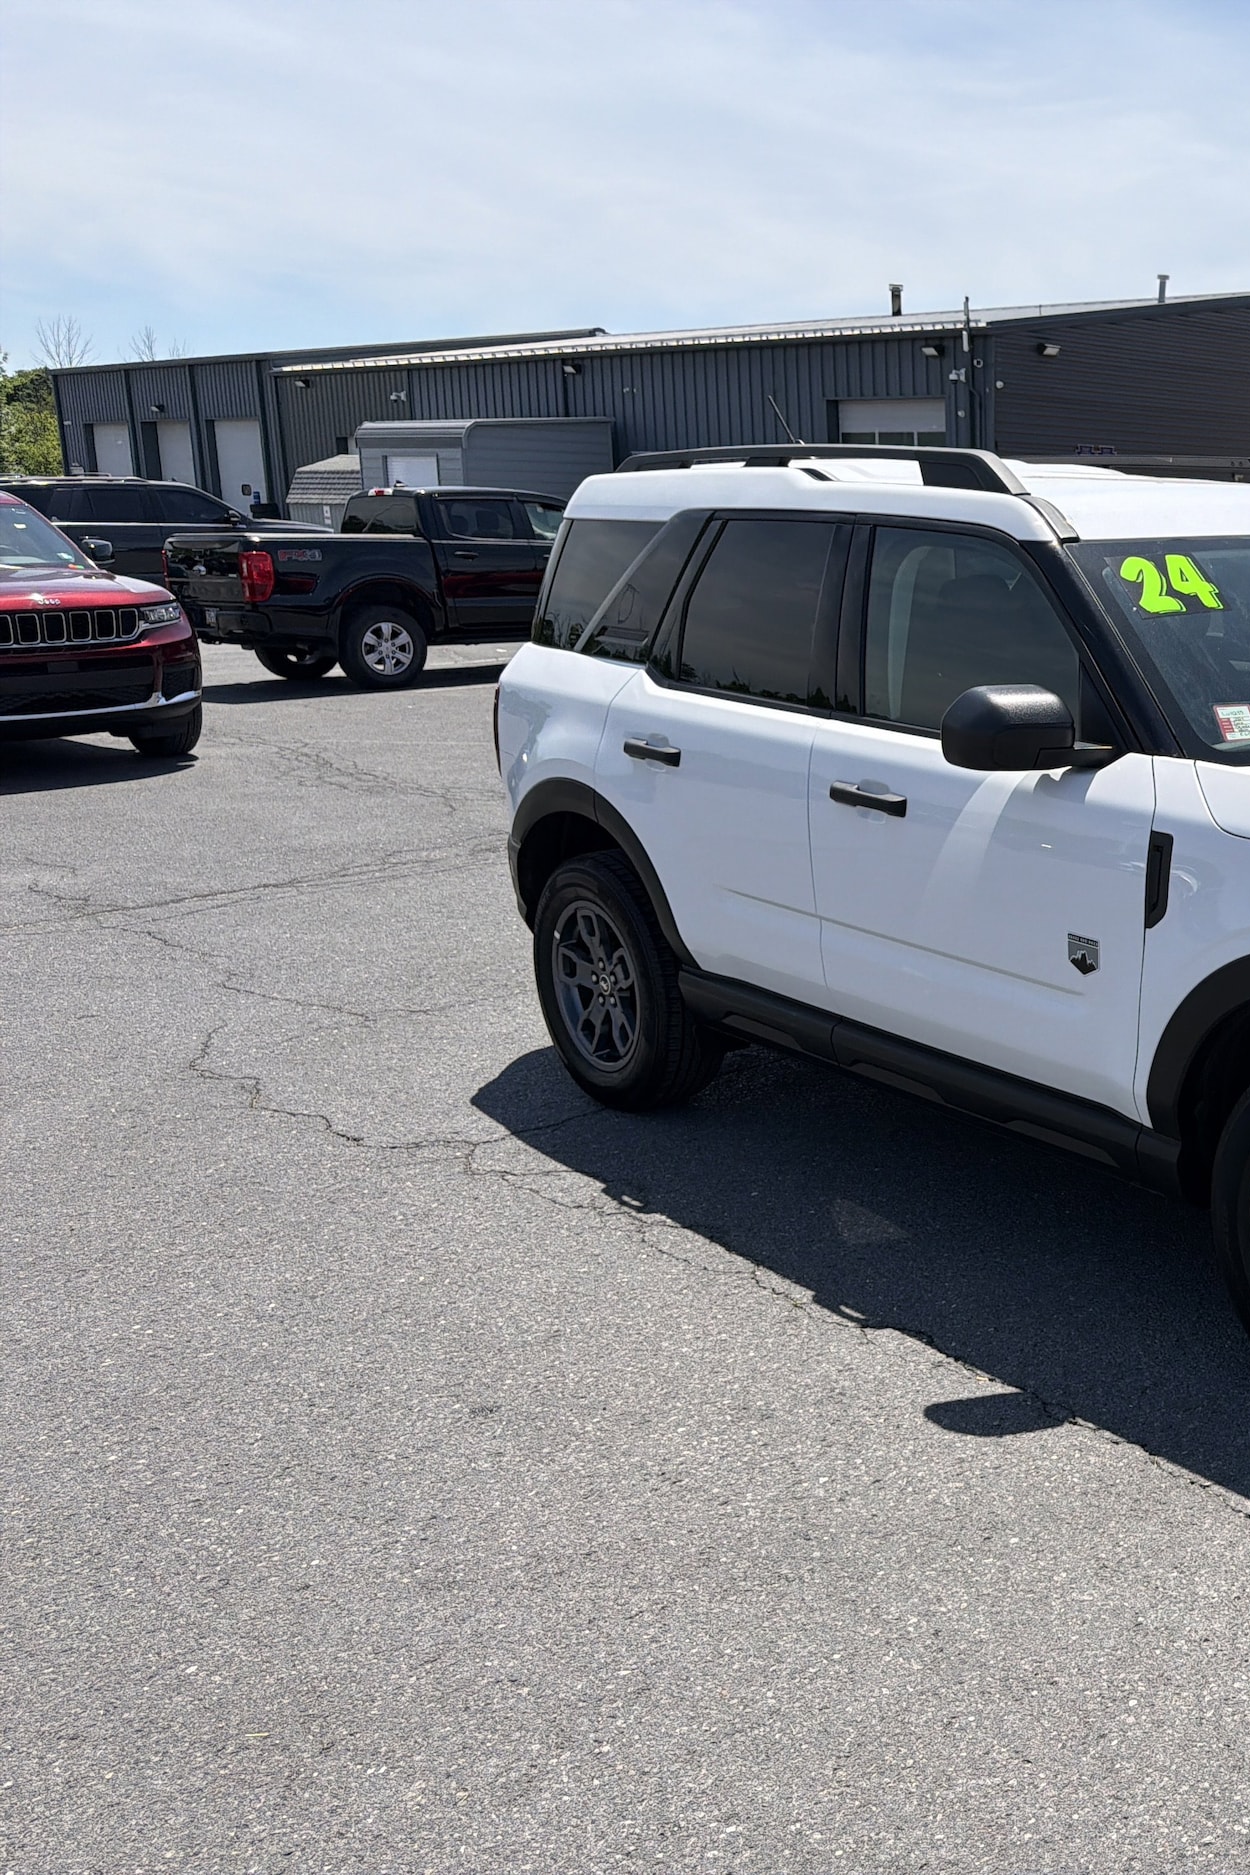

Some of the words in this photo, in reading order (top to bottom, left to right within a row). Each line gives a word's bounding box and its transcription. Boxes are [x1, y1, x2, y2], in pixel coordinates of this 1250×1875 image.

[277, 549, 323, 561] FX4
[1120, 554, 1224, 614] 24
[38, 598, 61, 606] Jeep
